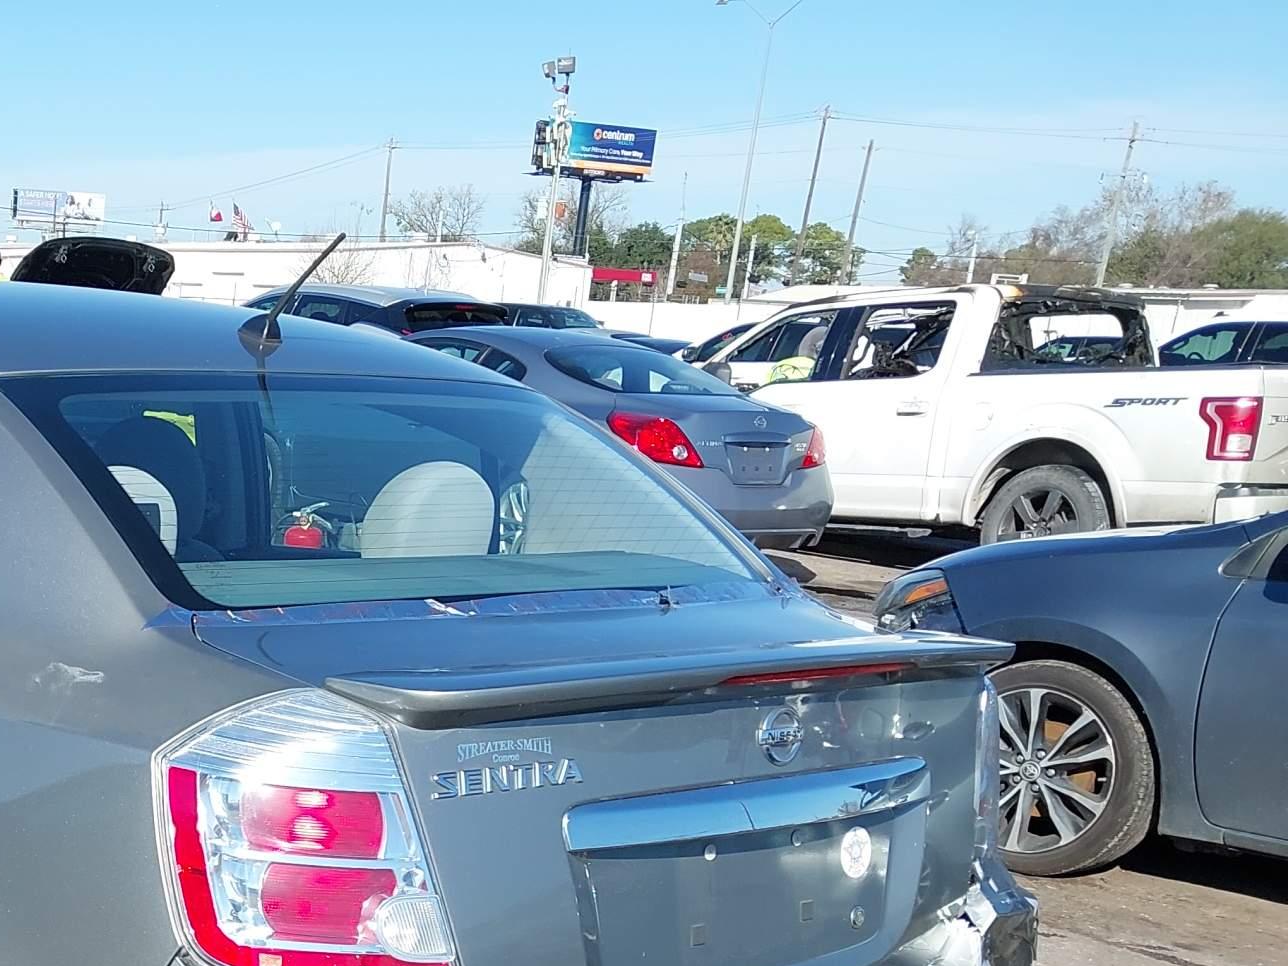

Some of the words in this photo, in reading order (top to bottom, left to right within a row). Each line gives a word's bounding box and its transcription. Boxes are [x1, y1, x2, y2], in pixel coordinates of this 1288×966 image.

[603, 130, 635, 142] centrum
[1103, 397, 1189, 408] SPORT
[456, 736, 553, 763] STREATER-SMITH
[430, 758, 584, 800] SENTRA
